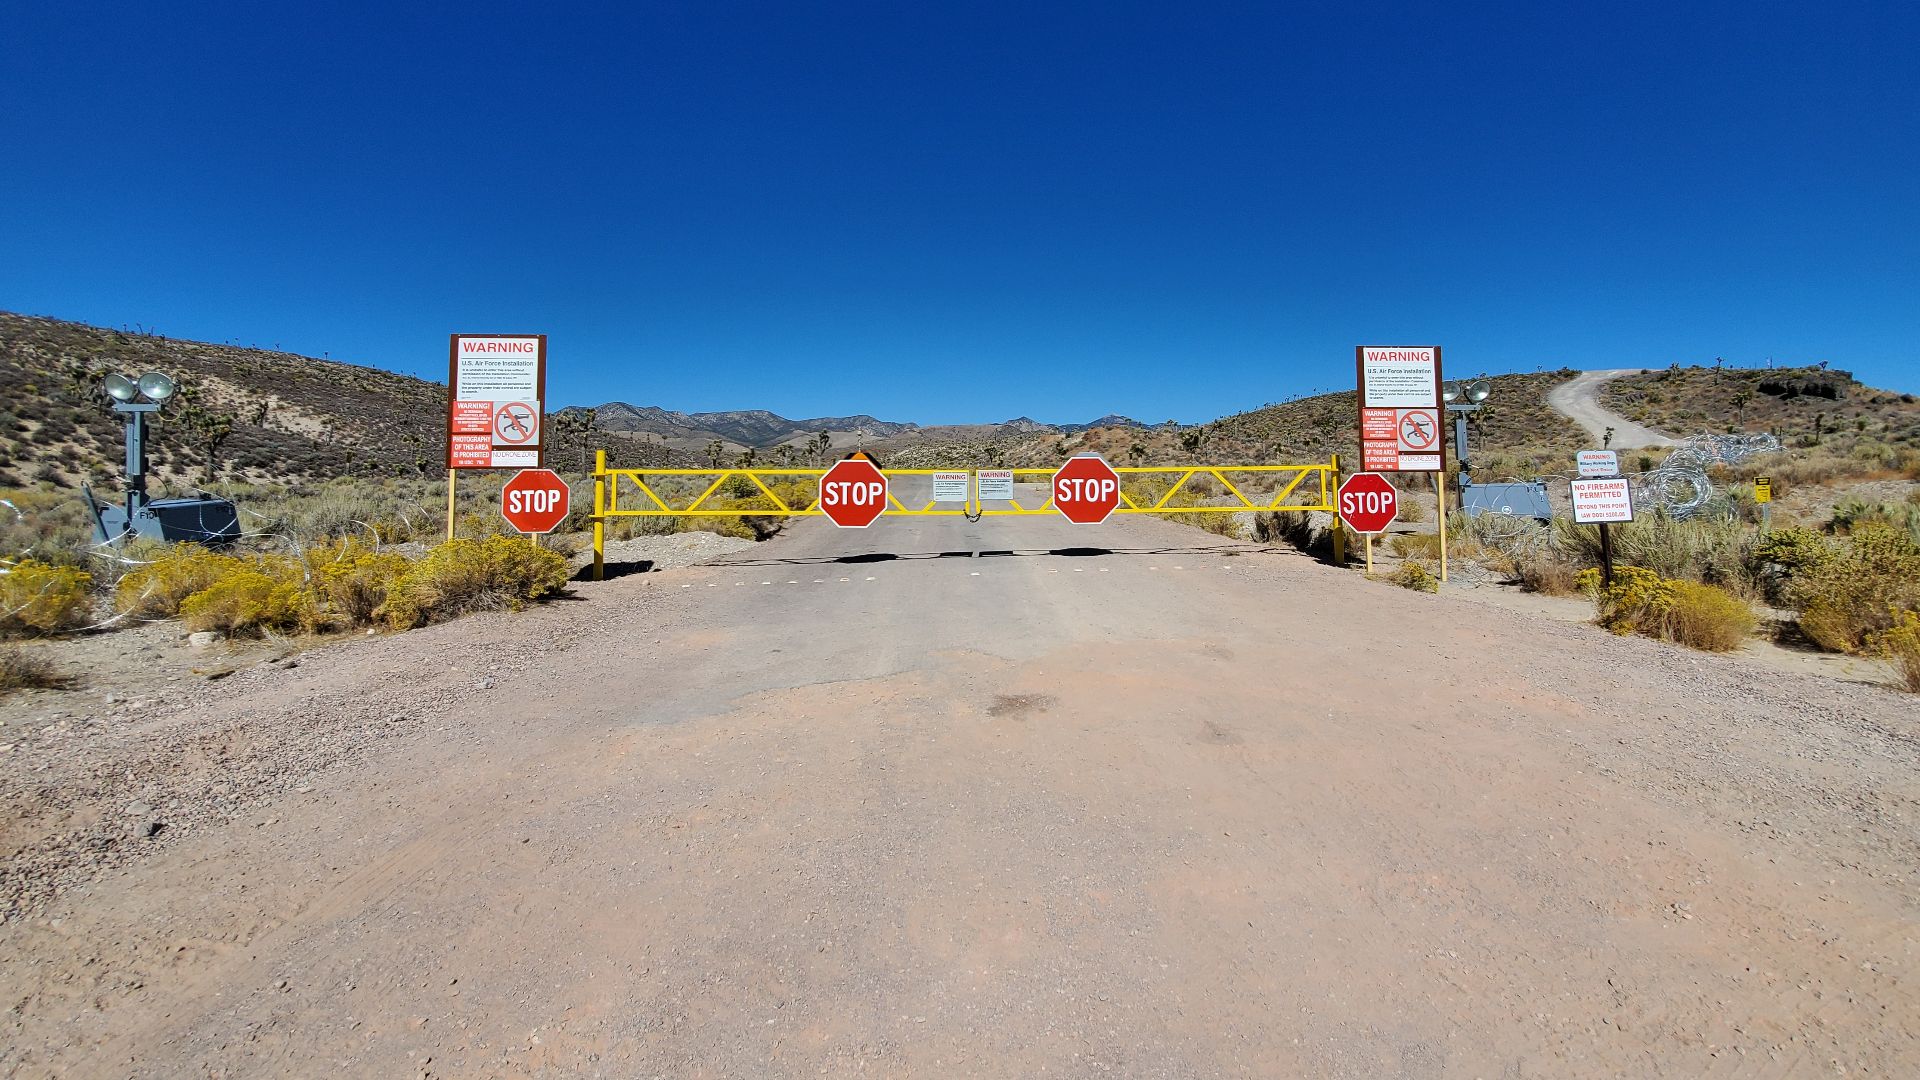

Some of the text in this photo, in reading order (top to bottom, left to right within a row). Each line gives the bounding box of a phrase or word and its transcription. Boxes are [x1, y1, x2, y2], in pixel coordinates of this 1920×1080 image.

[463, 342, 534, 353] WARNING
[1367, 351, 1430, 362] WARNING
[509, 489, 561, 513] STOP
[824, 482, 883, 506] STOP
[1058, 479, 1115, 502] STOP
[1343, 492, 1393, 514] STOP
